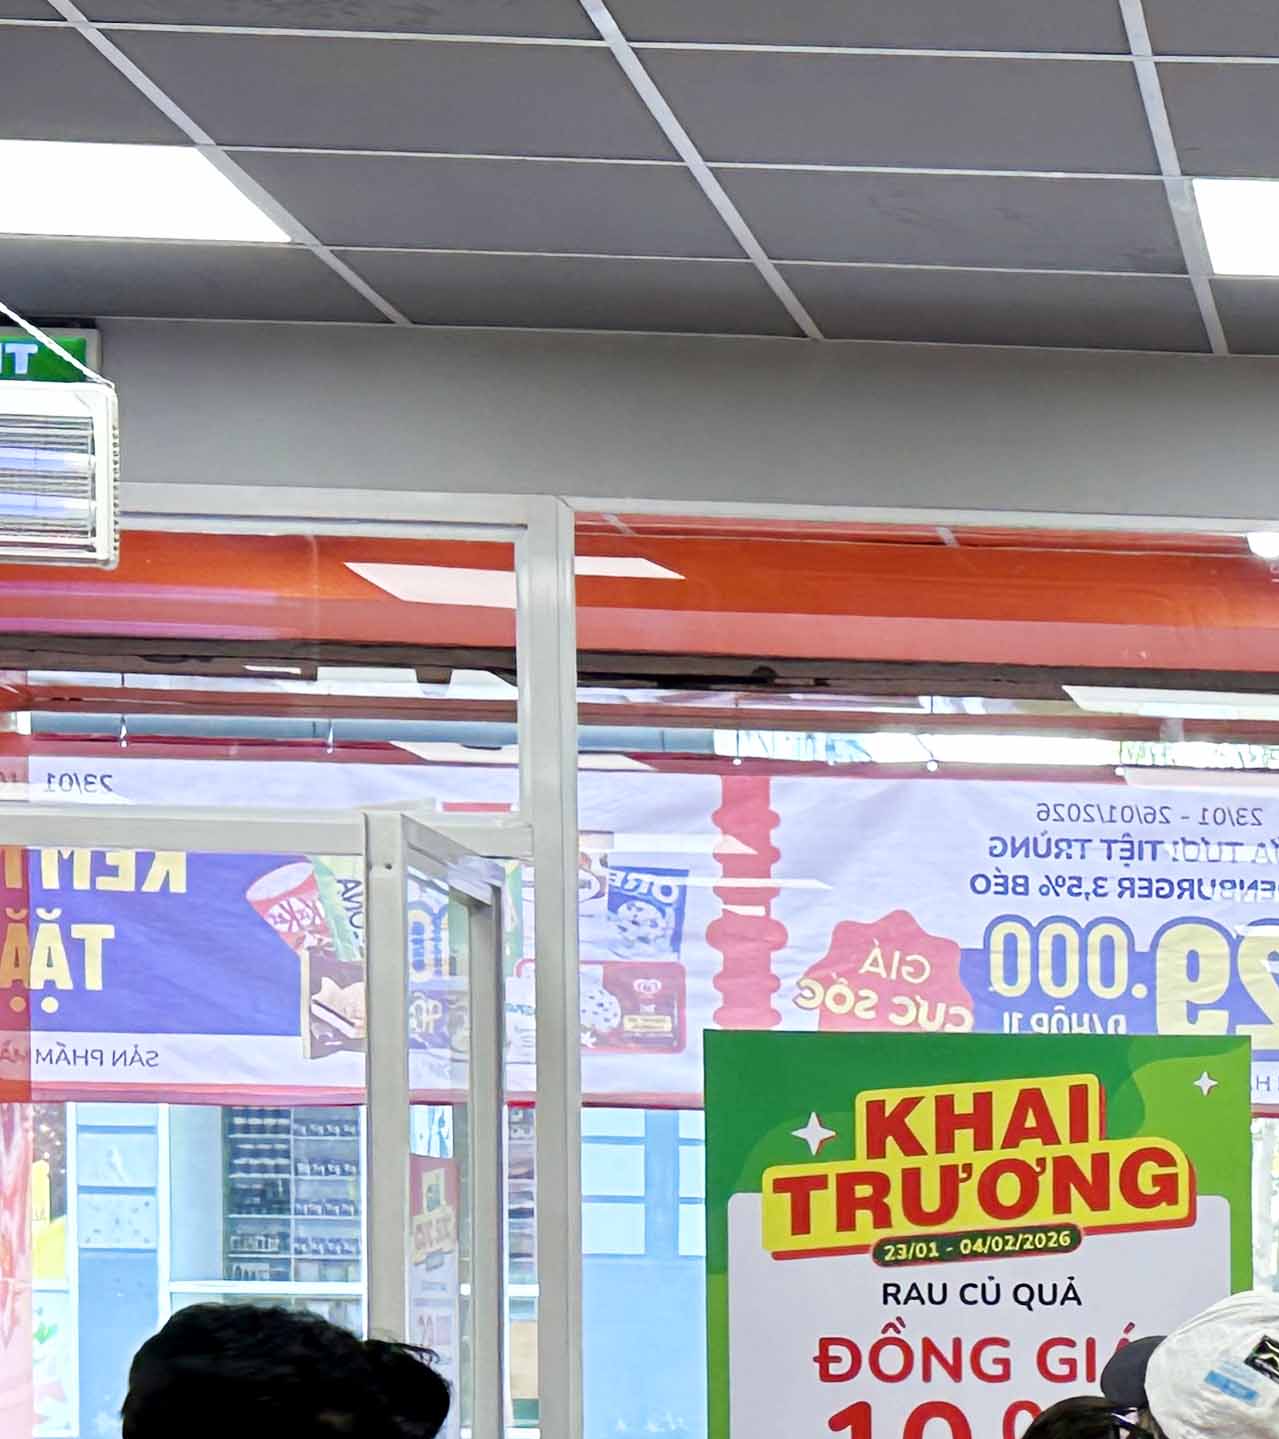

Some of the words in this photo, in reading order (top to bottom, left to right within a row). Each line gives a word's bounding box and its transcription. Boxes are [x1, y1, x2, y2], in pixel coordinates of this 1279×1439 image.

[865, 1083, 1090, 1160] KHAI
[771, 1145, 1180, 1236] TRƯƠNG
[884, 1243, 939, 1261] 23/01
[960, 1231, 1072, 1254] 04/02/2026
[881, 1282, 948, 1306] RAU
[959, 1276, 1001, 1306] CỦ
[1012, 1276, 1082, 1311] QUẢ
[812, 1316, 1012, 1384] ĐỒNG
